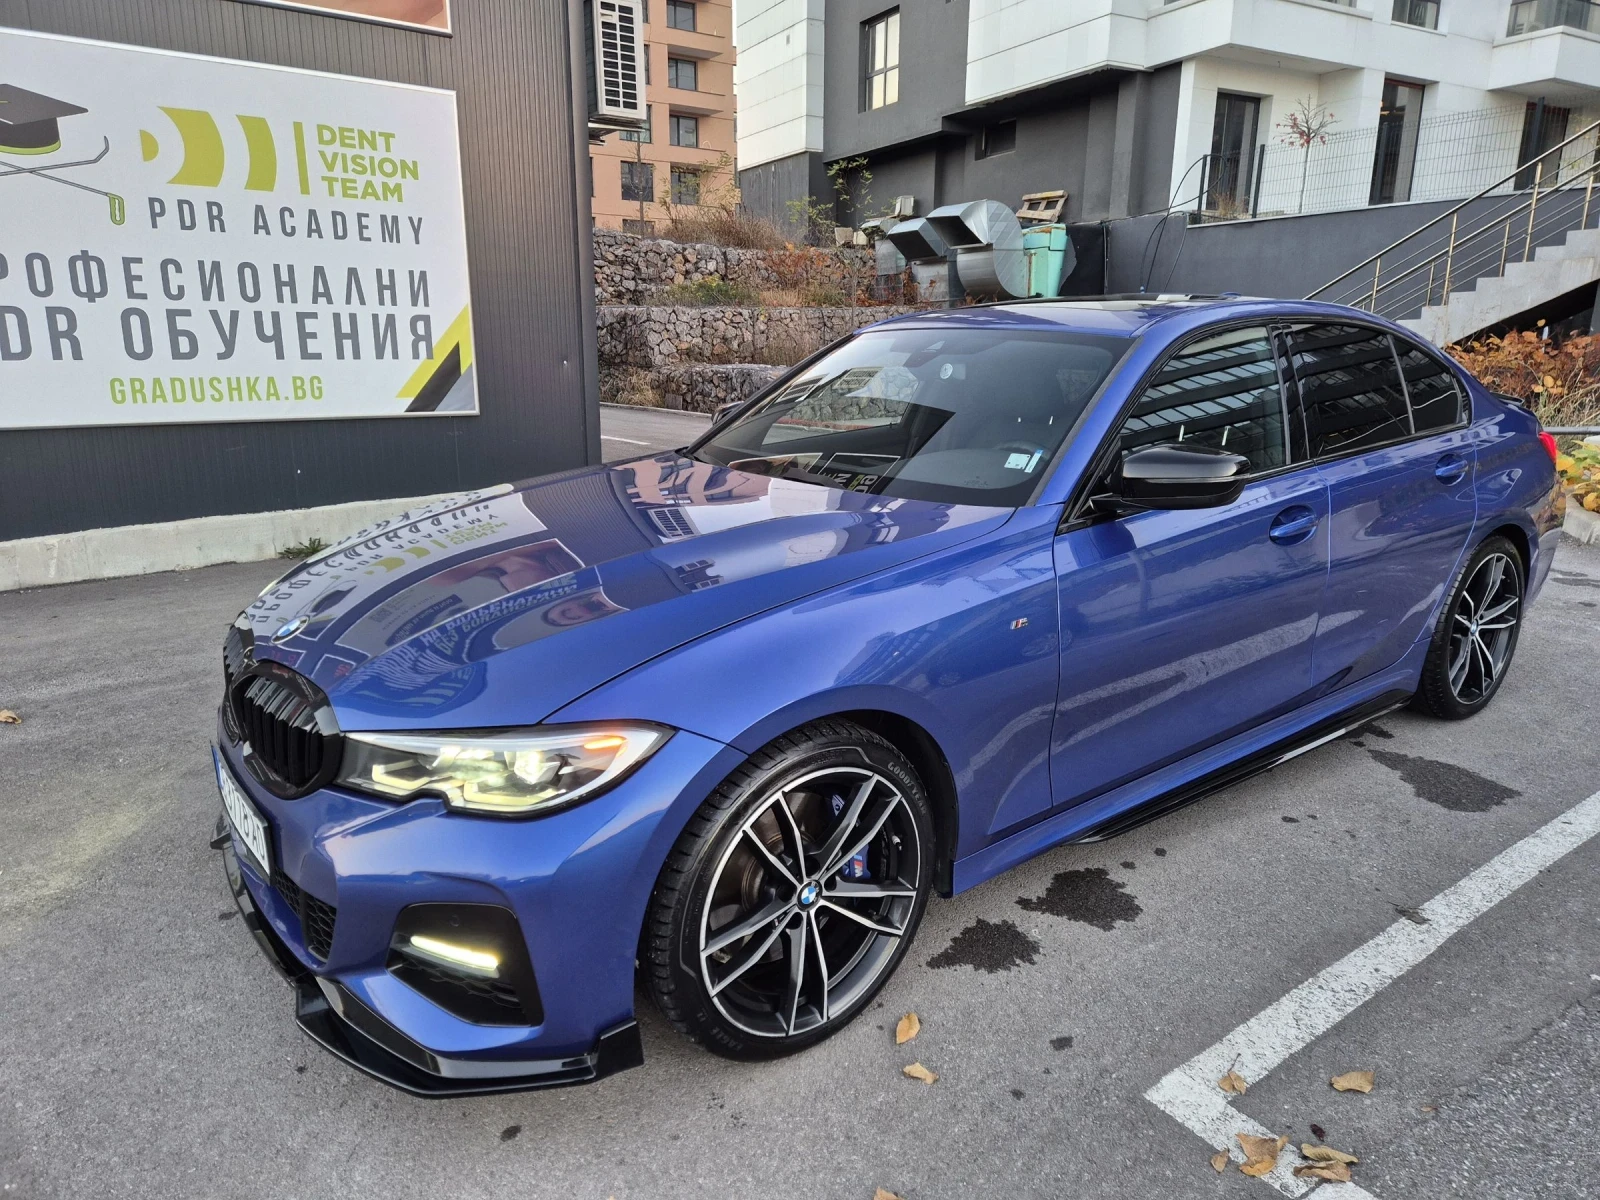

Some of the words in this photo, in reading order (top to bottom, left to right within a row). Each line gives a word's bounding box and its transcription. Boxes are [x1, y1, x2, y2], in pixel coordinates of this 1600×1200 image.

[316, 124, 396, 152] DENT
[318, 150, 420, 180] VISION
[321, 176, 404, 203] TEAM
[148, 197, 227, 233] PDR
[253, 204, 423, 245] ACADEMY
[120, 307, 434, 361] ОБУЧЕНИЯ
[109, 375, 324, 405] GRADUSHKA.BG
